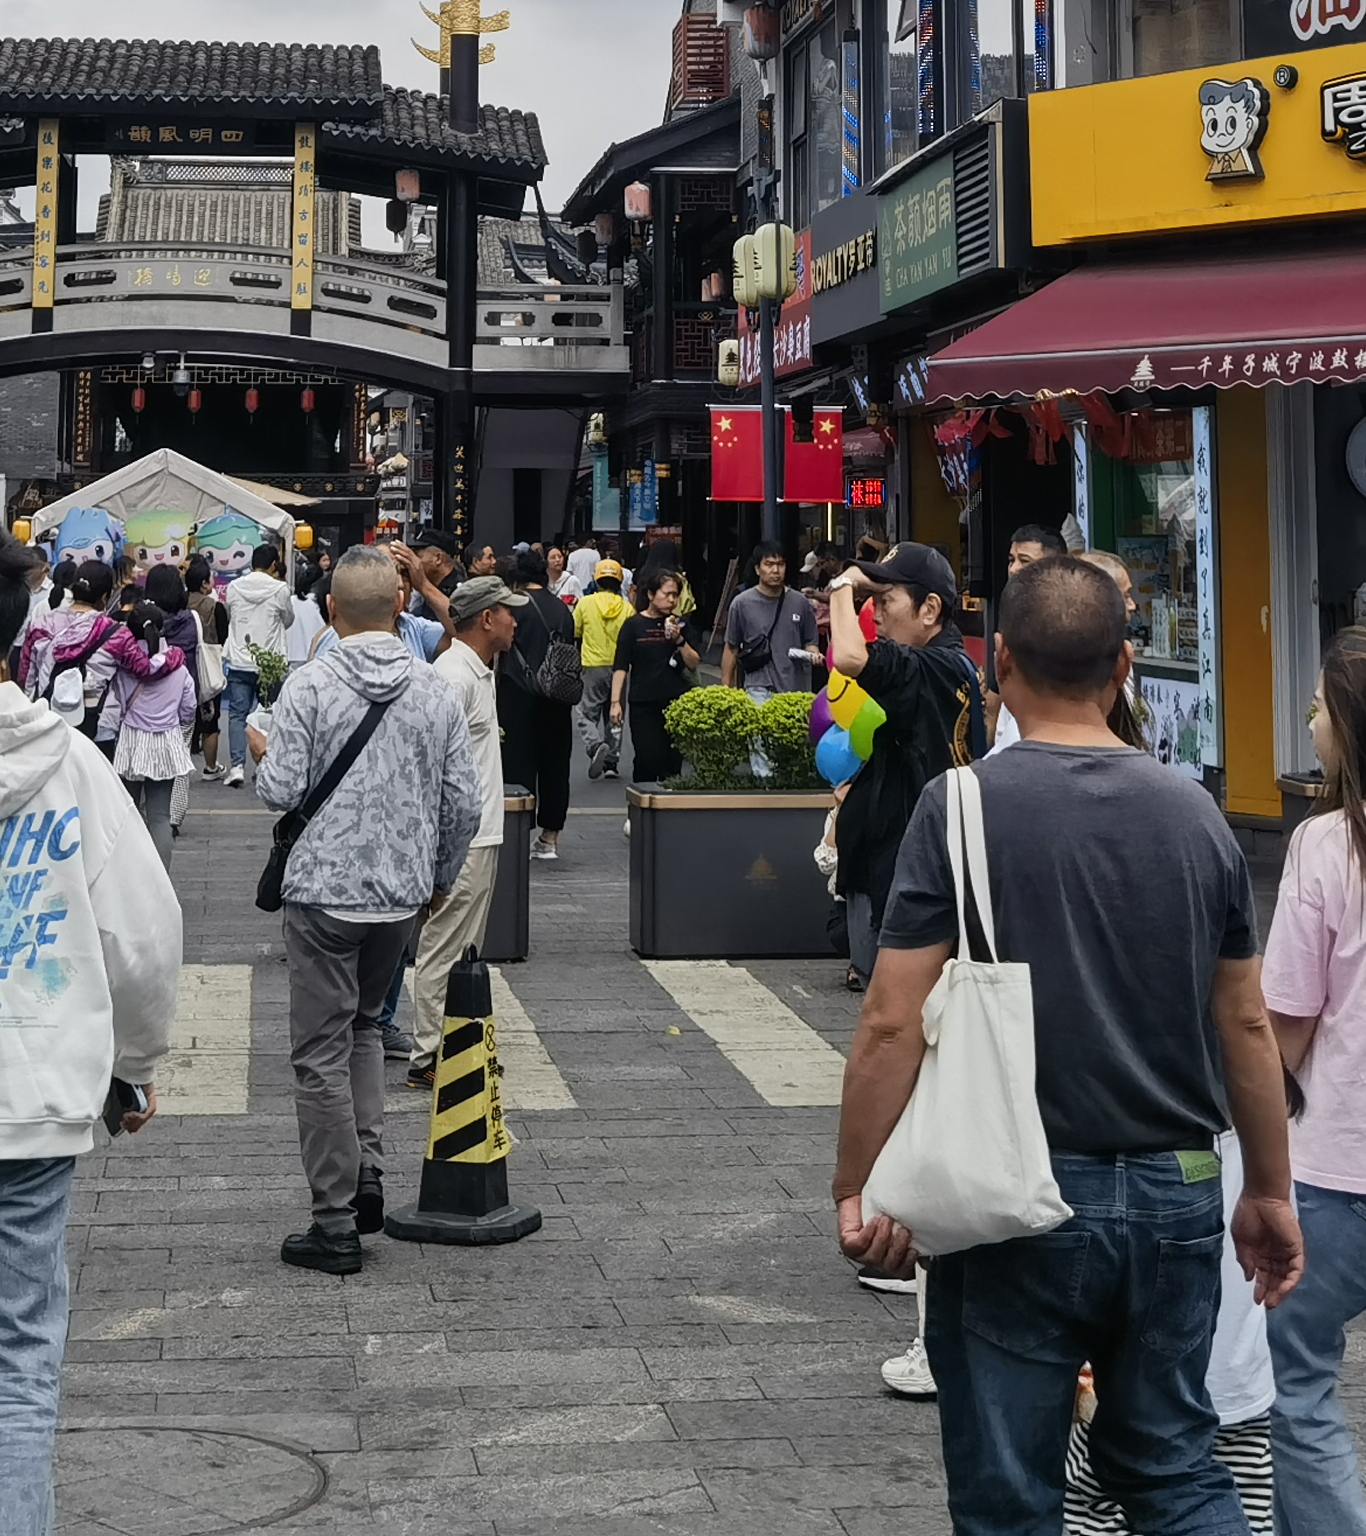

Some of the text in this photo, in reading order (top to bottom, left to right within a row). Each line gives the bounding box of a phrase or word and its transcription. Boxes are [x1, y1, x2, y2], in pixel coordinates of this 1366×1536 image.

[811, 243, 850, 295] ROYALTY
[487, 1055, 507, 1151] 禁止停车
